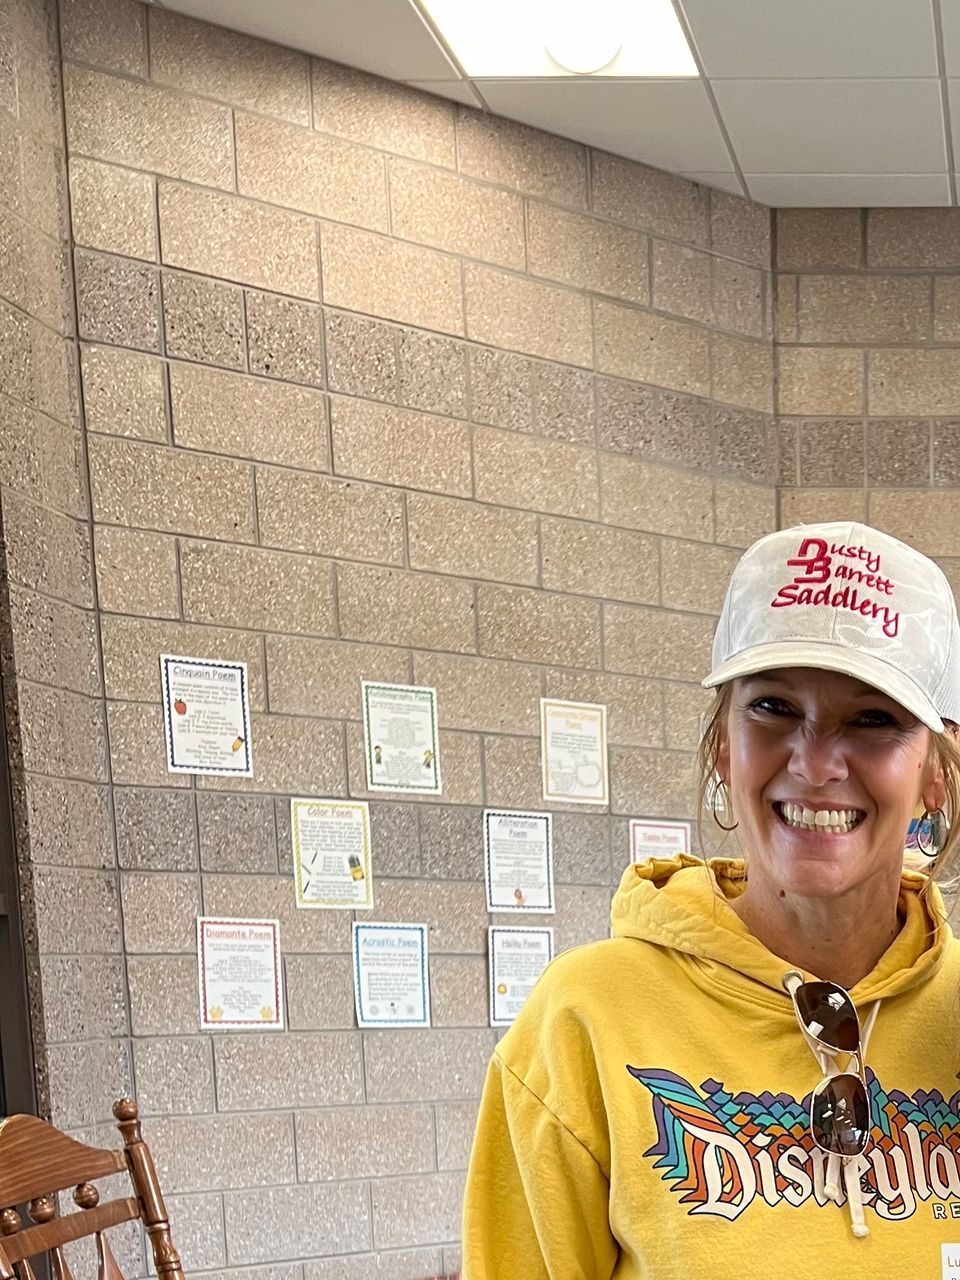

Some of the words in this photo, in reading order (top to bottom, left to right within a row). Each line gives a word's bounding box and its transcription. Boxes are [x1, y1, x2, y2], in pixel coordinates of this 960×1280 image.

[787, 538, 880, 573] Dusty
[794, 556, 895, 596] Barrett
[771, 583, 899, 637] Saddlery
[173, 666, 211, 679] Cinquain
[212, 669, 237, 681] Poem
[331, 808, 353, 818] Poem
[205, 927, 247, 939] Diamante
[248, 928, 272, 940] Poem
[362, 937, 396, 948] Acrostic
[398, 938, 418, 948] Poem
